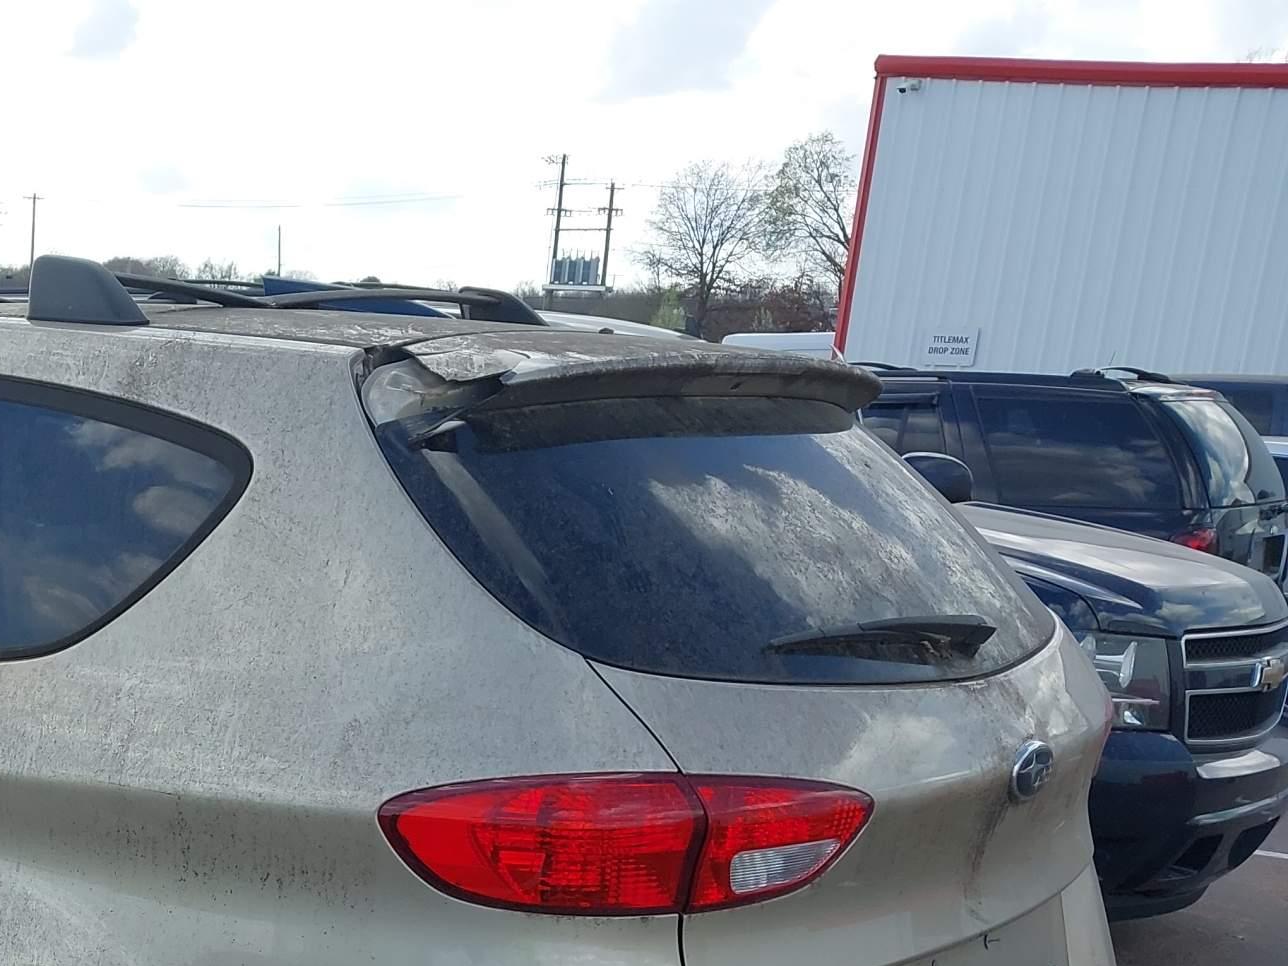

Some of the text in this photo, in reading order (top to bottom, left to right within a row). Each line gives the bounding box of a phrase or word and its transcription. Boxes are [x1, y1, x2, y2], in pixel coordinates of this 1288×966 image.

[933, 335, 969, 344] TITLEMAX
[928, 346, 970, 356] DROP ZONE
